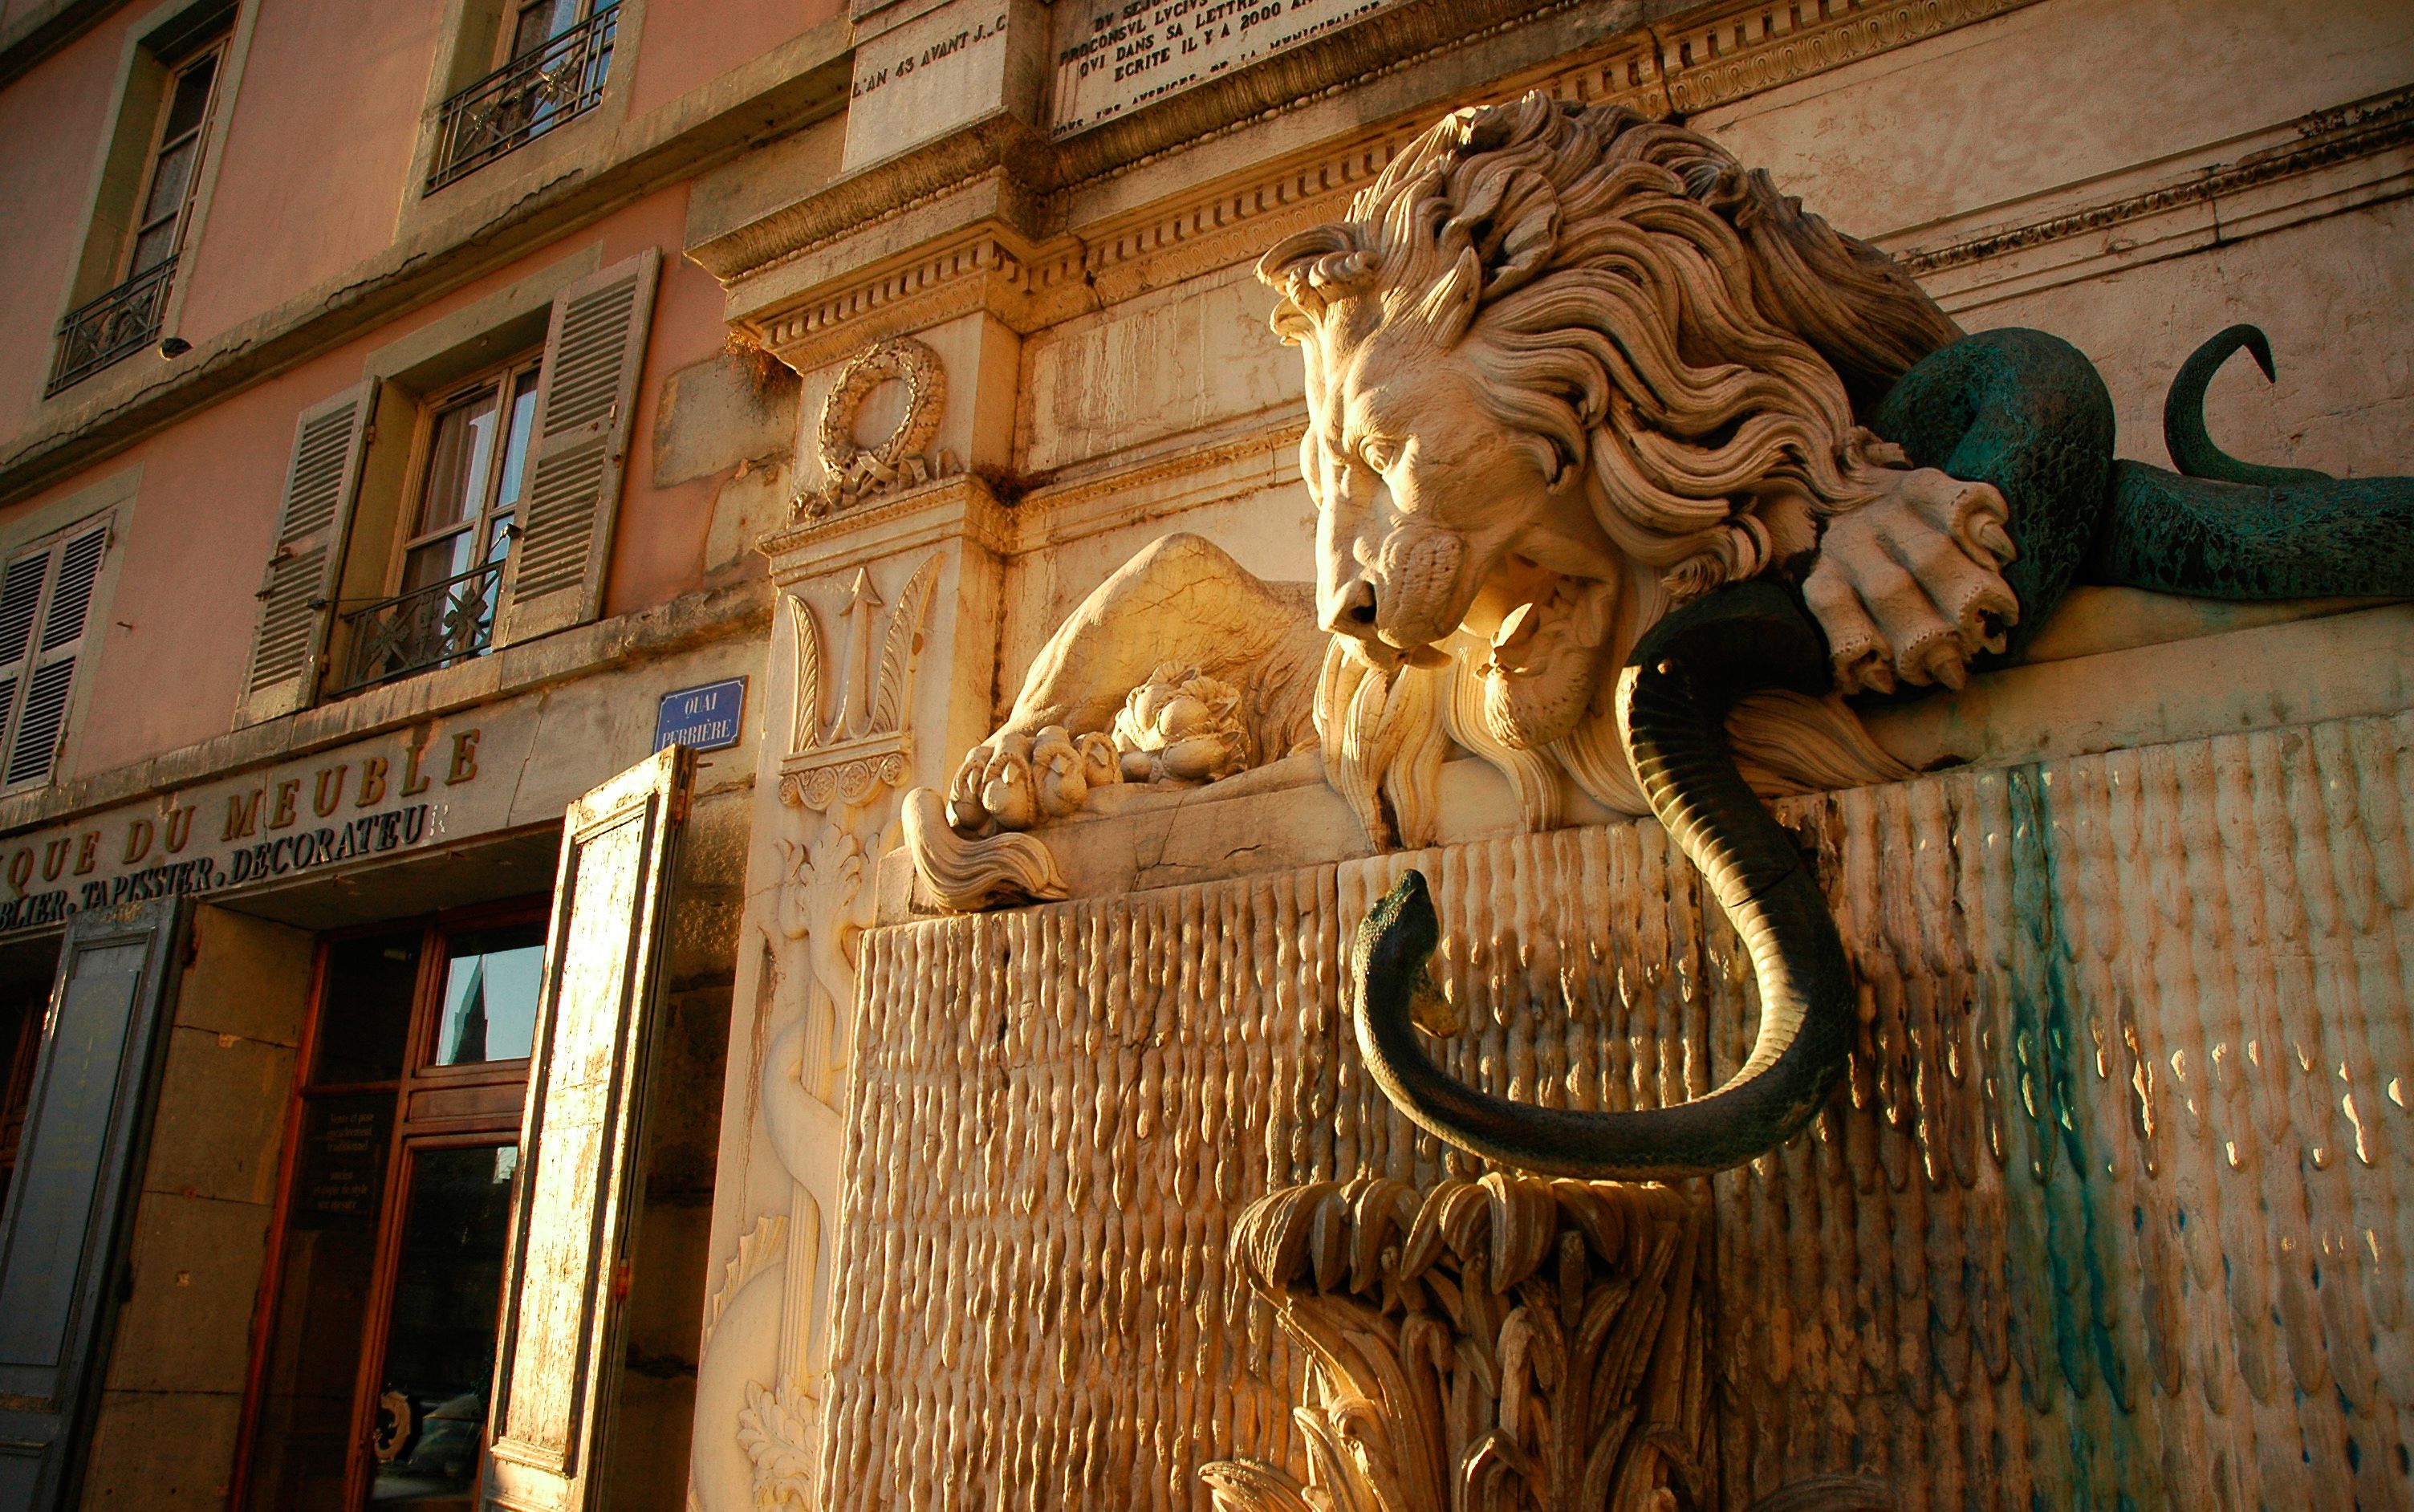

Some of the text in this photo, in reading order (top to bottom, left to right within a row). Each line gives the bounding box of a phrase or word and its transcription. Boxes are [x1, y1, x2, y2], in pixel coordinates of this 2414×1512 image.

[1060, 18, 1146, 67] PROCONSVL
[1095, 12, 1114, 33] DV
[1115, 47, 1171, 82] ECRITE
[1181, 36, 1198, 55] IL
[1204, 29, 1213, 45] Y
[1221, 22, 1230, 39] A
[1241, 2, 1282, 31] 2000
[1116, 34, 1155, 62] DANS
[1166, 22, 1184, 40] SA
[852, 68, 888, 99] L'AN
[920, 30, 969, 67] AVANT
[685, 693, 717, 718] QUAI
[0, 728, 482, 898] QUE DU MEUBLE
